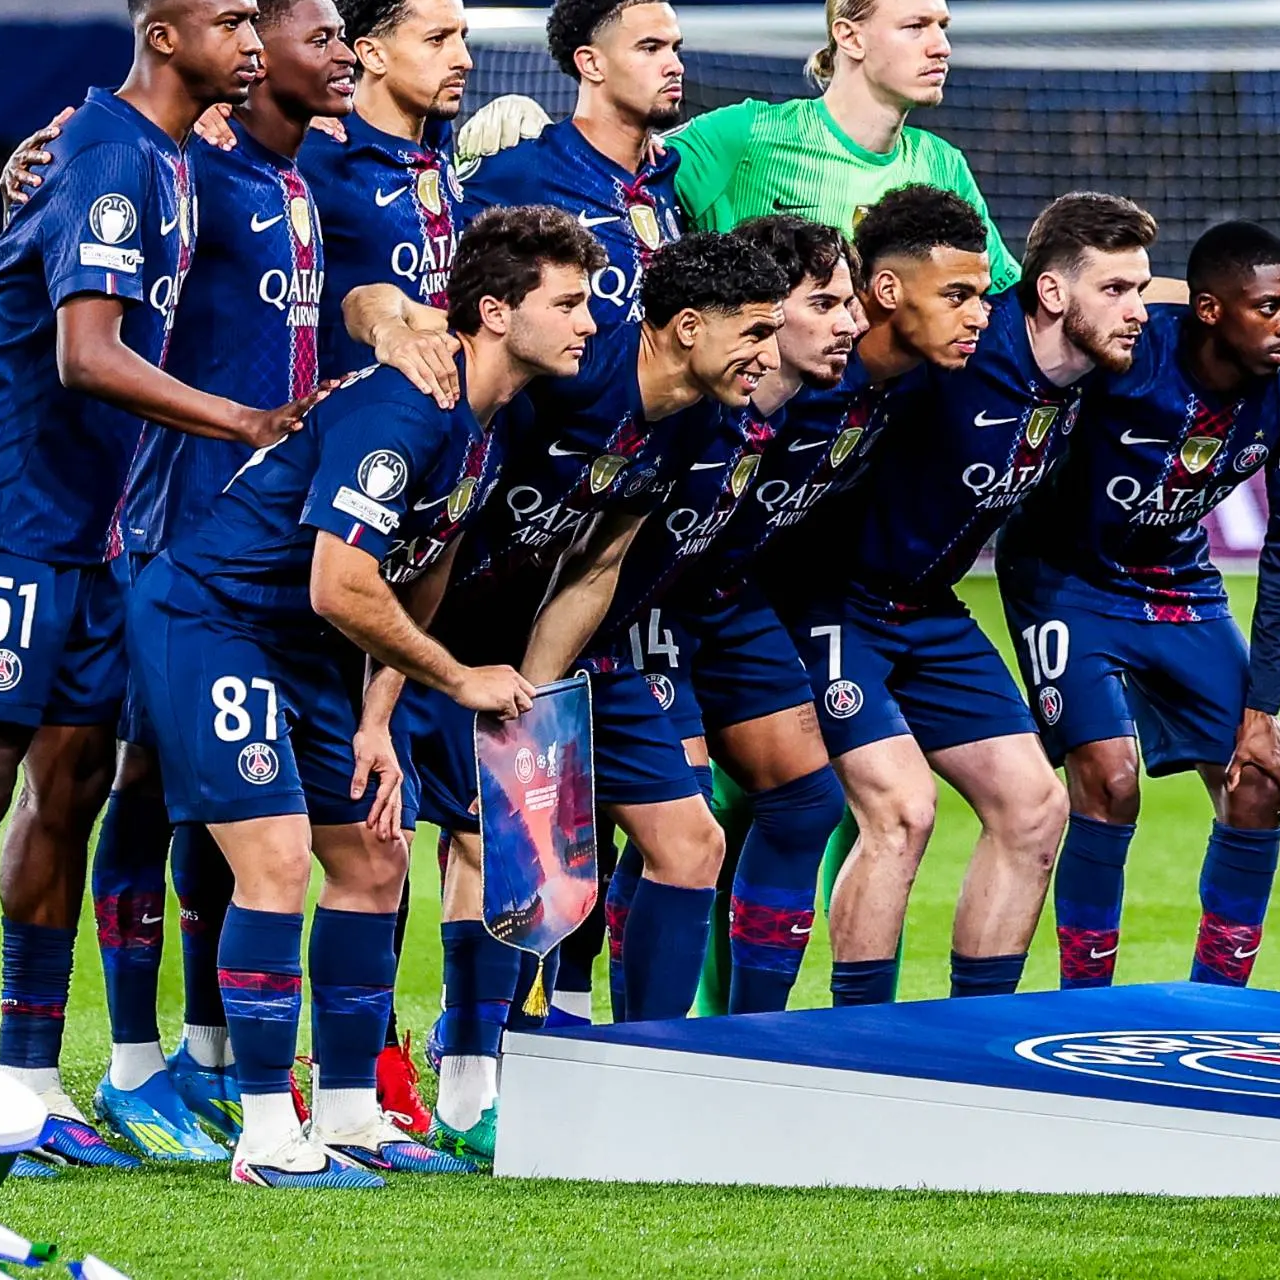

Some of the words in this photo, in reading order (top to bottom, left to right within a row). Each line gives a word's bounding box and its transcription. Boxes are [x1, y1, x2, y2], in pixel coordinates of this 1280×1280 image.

[628, 608, 680, 670] 14
[810, 625, 842, 681] 7
[1022, 620, 1069, 686] 10
[211, 676, 278, 743] 87
